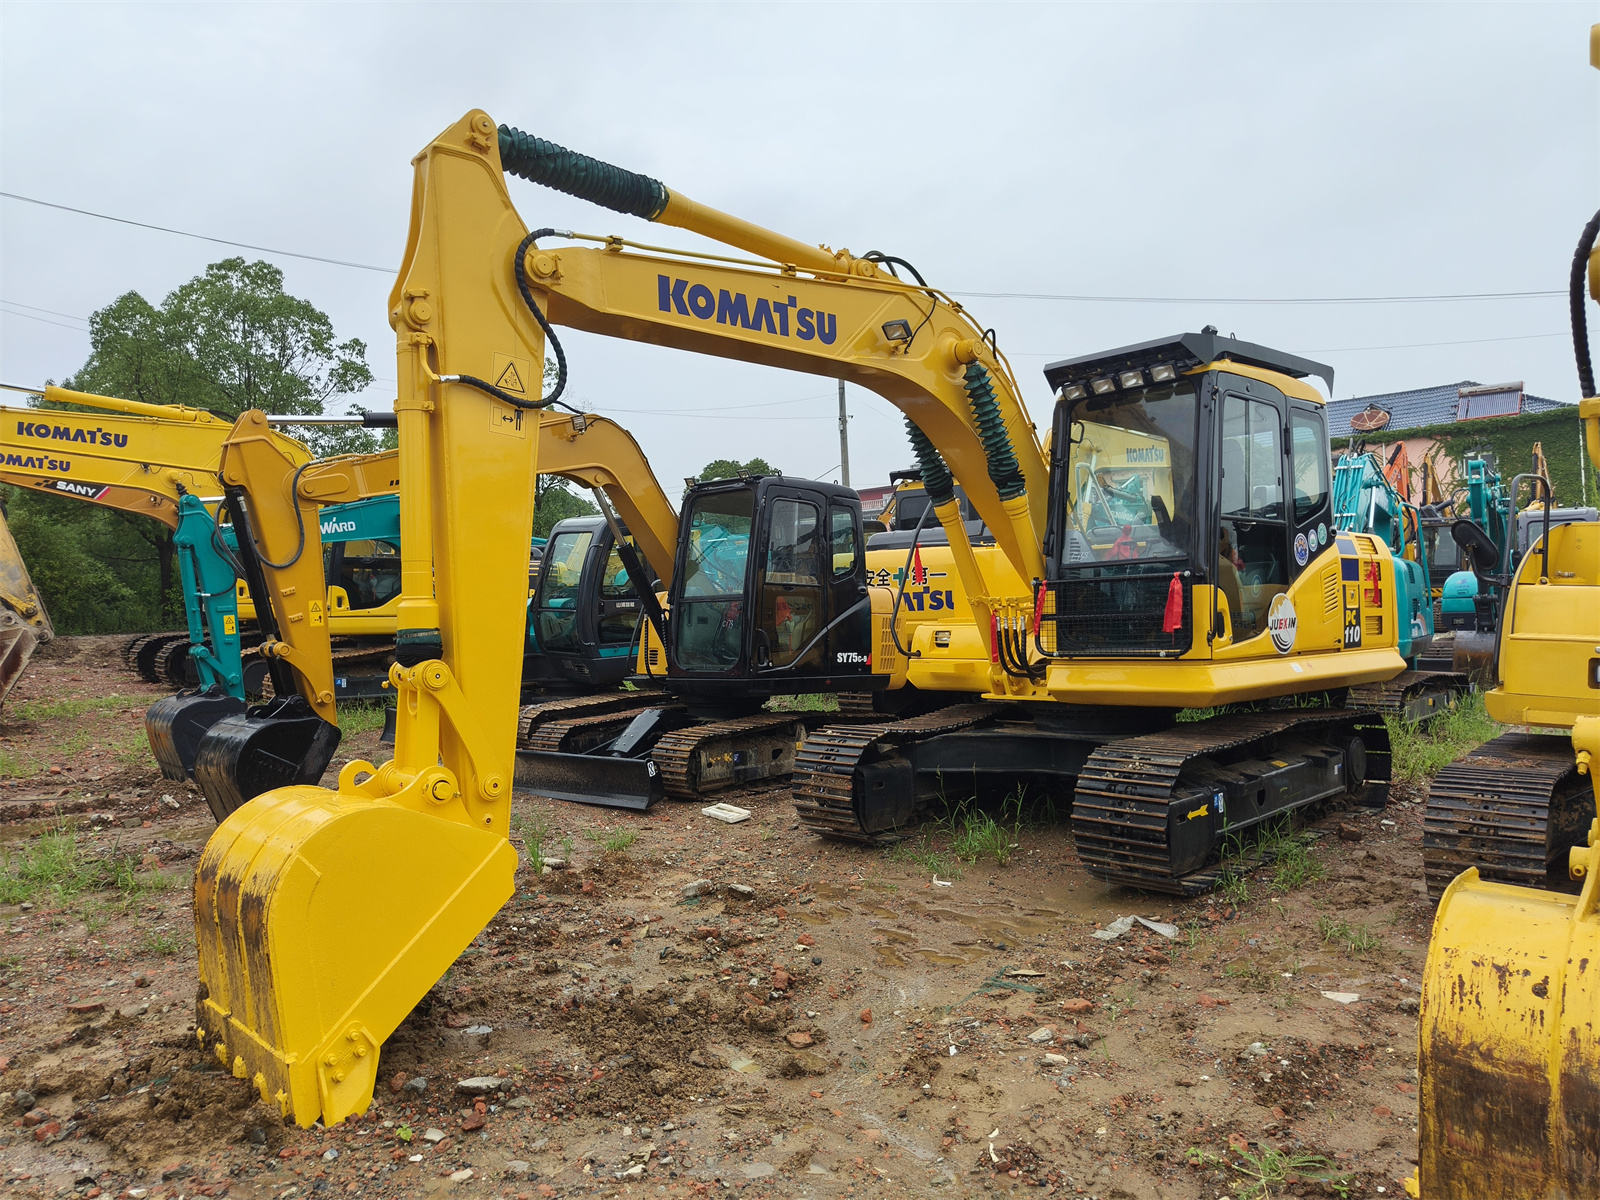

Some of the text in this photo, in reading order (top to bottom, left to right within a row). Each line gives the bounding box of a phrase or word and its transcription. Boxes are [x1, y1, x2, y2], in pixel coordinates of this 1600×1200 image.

[658, 274, 837, 345] KOMATSU
[17, 421, 128, 448] KOMATSU
[1126, 445, 1164, 463] KOMATSU
[56, 480, 96, 497] SANY
[1269, 618, 1297, 631] JUEXIN
[1345, 610, 1357, 626] PC
[1344, 626, 1361, 643] 110
